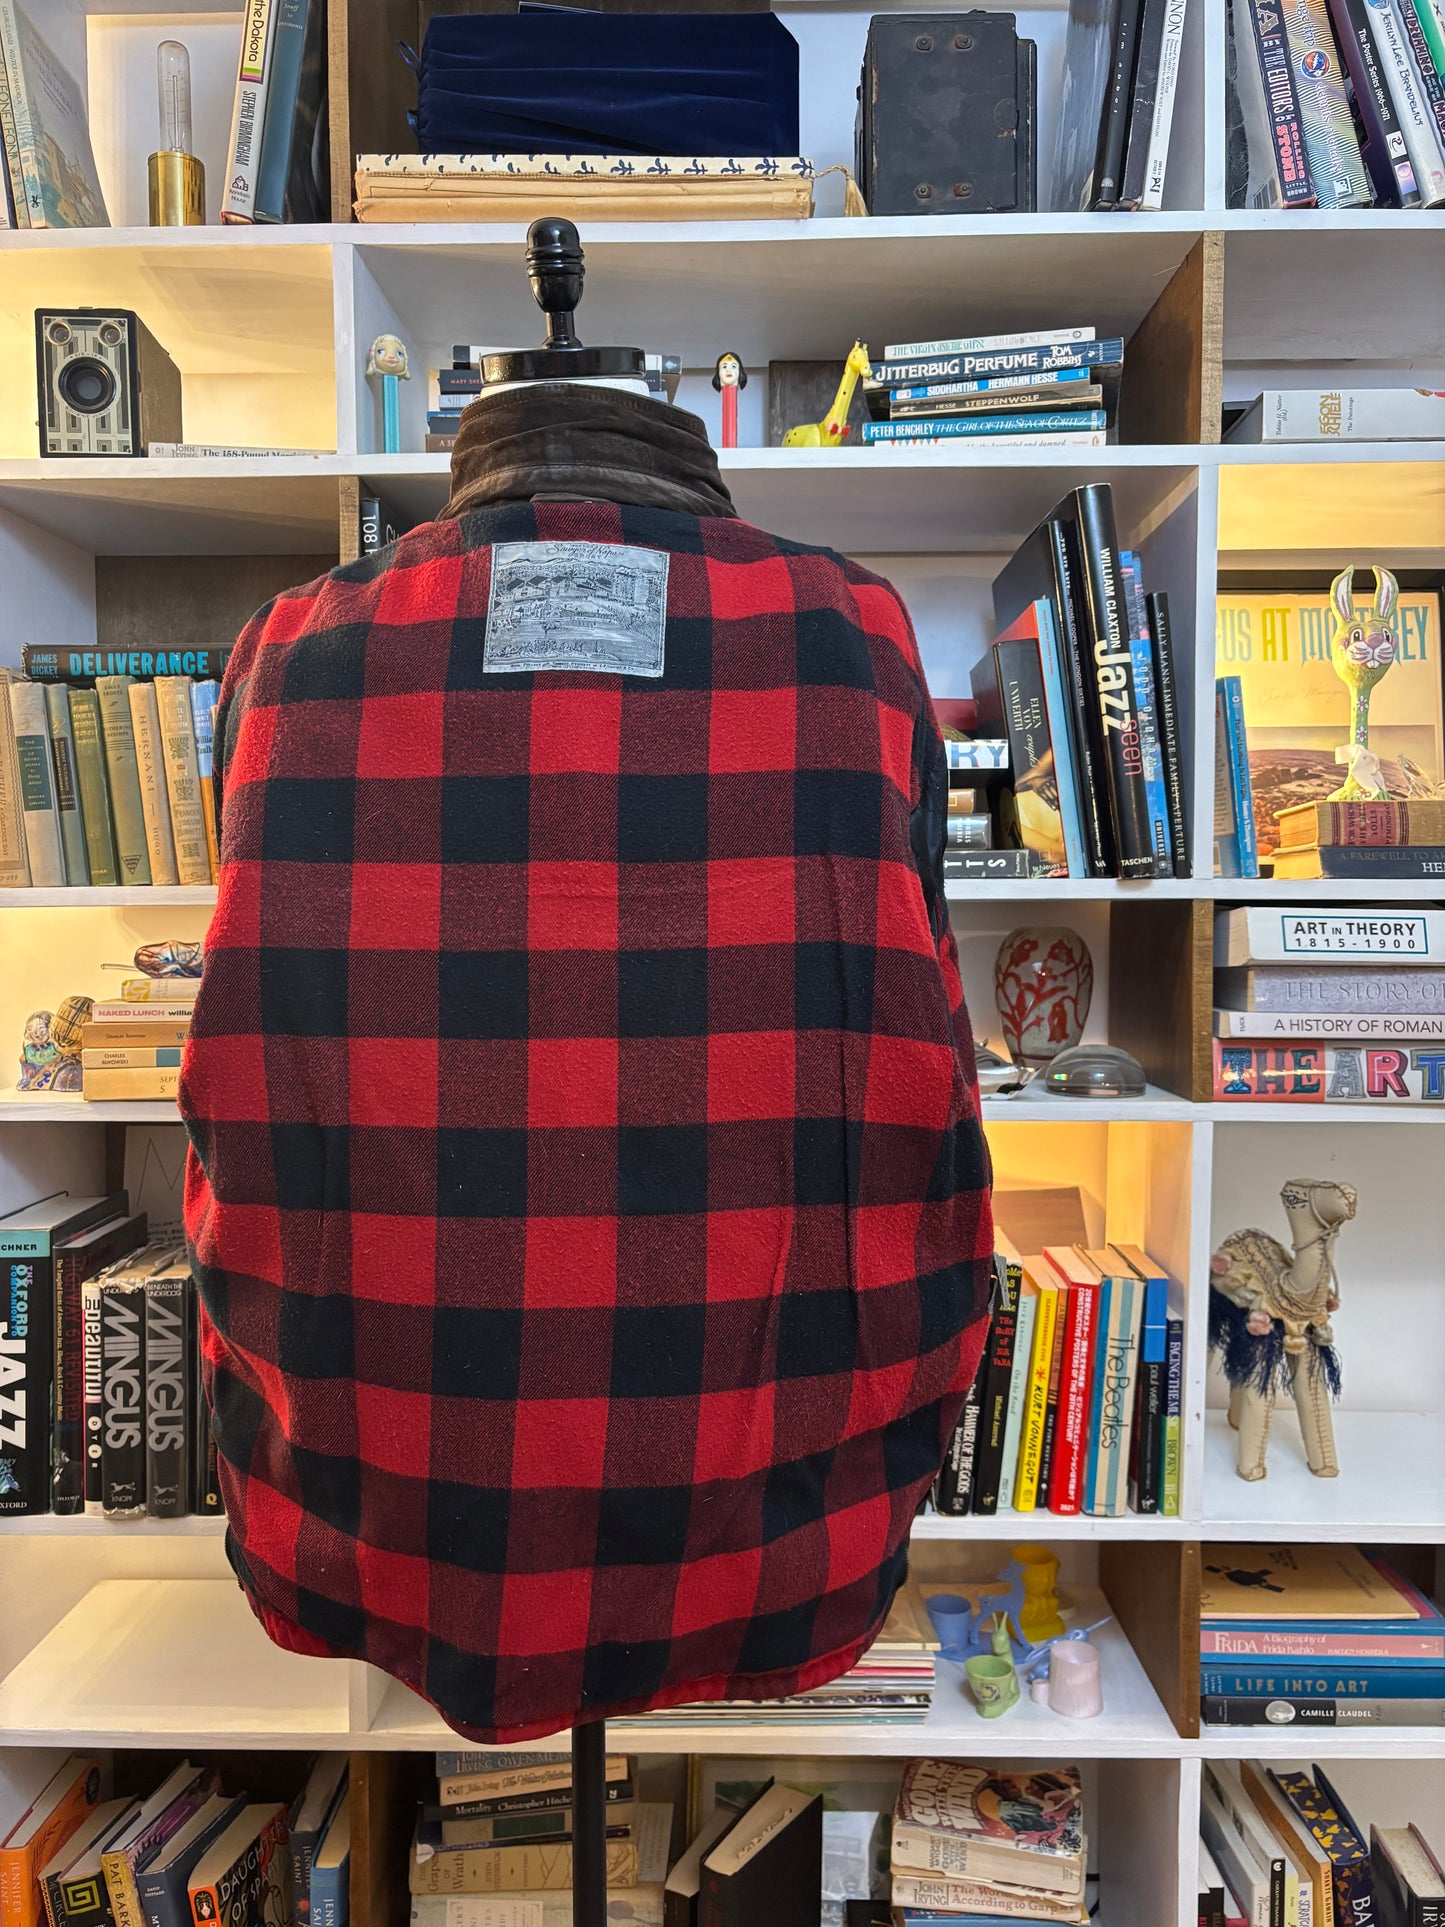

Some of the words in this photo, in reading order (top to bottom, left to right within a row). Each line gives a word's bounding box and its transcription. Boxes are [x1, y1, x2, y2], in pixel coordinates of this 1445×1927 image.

[249, 20, 264, 62] Dakota
[1407, 18, 1435, 76] DRUMMING
[1264, 48, 1286, 68] THE
[1358, 28, 1368, 43] The
[1363, 43, 1375, 66] Poster
[1369, 65, 1380, 85] Series
[240, 91, 256, 120] STEPHEN
[1267, 68, 1294, 114] EDITORS
[235, 120, 254, 166] BIRMINGHAM
[1276, 125, 1297, 182] STONE
[1291, 122, 1306, 179] ROLLING
[893, 346, 908, 356] THE
[910, 344, 936, 354] VIRGIN
[1042, 355, 1082, 369] ROBBINS
[1050, 345, 1072, 358] TOM
[876, 359, 959, 382] JITTERBUG
[964, 352, 1038, 374] PERFUME
[927, 381, 978, 396] SIDDHARTHA
[988, 374, 1030, 390] HERMANN
[1031, 371, 1058, 385] HESSE
[936, 402, 956, 410] HESSE
[965, 394, 1040, 408] STEPPENWOLF
[870, 424, 894, 438] PETER
[896, 422, 934, 437] BENCHLEY
[176, 444, 195, 452] JOHN
[202, 448, 220, 457] The
[1100, 548, 1116, 597] WILLIAM
[1106, 600, 1121, 648] CLAXTON
[1156, 612, 1166, 646] SALLY
[1261, 608, 1290, 662] AT
[32, 654, 58, 664] JAMES
[32, 666, 58, 676] DICKEY
[69, 652, 210, 676] DELIVERANCE
[1160, 651, 1170, 684] MANN
[1094, 640, 1132, 736] Jazz
[1008, 680, 1024, 732] UNWERTH
[1022, 708, 1032, 730] VON
[1030, 696, 1042, 728] ELLEN
[1163, 689, 1176, 754] IMMEDIATE
[1026, 734, 1038, 768] couples
[1120, 720, 1142, 776] seen
[139, 715, 156, 792] HERNANI
[152, 827, 161, 857] HUGO
[1169, 758, 1180, 800] FAMILY
[1173, 804, 1185, 862] APERTURE
[1370, 810, 1378, 836] TOLLS
[1156, 821, 1166, 856] UNIVERSE
[1120, 856, 1153, 866] TASCHEN
[1294, 922, 1328, 935] ART
[1331, 926, 1342, 935] IN
[1346, 922, 1416, 936] THEORY
[1283, 981, 1330, 1000] THE
[1338, 982, 1416, 1000] STORY
[1274, 1018, 1286, 1032] A
[1289, 1018, 1354, 1032] HISTORY
[1357, 1018, 1380, 1032] OF
[1383, 1020, 1444, 1034] ROMAN
[1221, 1047, 1322, 1095] THE
[1325, 1047, 1445, 1100] ART
[26, 1265, 34, 1285] THE
[10, 1264, 18, 1322] COMPANION
[16, 1264, 28, 1337] OXFORD
[1074, 1288, 1084, 1338] CONSTRUCTIVE
[11, 1324, 18, 1337] TO
[1072, 1338, 1080, 1368] POSTERS
[1108, 1333, 1136, 1372] The
[1169, 1342, 1182, 1378] FACING
[0, 1322, 26, 1450] JAZZ
[64, 1352, 82, 1422] REVISITED
[104, 1296, 142, 1449] MINGUS
[147, 1298, 184, 1452] MINGUS
[1071, 1369, 1078, 1378] OF
[1149, 1364, 1160, 1385] paul
[1032, 1384, 1044, 1418] KURT
[1149, 1386, 1160, 1414] weller
[1168, 1379, 1180, 1400] THE
[964, 1405, 980, 1442] HAMMER
[1102, 1375, 1130, 1449] Beatles
[1166, 1401, 1179, 1432] MUSIC
[1066, 1411, 1074, 1444] CENTURY
[960, 1456, 972, 1470] THE
[962, 1442, 973, 1456] OF
[1026, 1420, 1040, 1484] VONNEGUT
[1167, 1440, 1178, 1476] BROWN
[957, 1470, 972, 1494] GODS
[1214, 1632, 1259, 1654] FRIDA
[1263, 1634, 1270, 1642] A
[1271, 1635, 1316, 1646] Biography
[1317, 1634, 1326, 1644] of
[1263, 1645, 1285, 1654] Frida
[1286, 1645, 1314, 1654] Kahlo
[1236, 1678, 1274, 1692] LIFE
[1284, 1679, 1328, 1692] INTO
[1336, 1680, 1369, 1693] ART
[1300, 1709, 1334, 1717] CAMILLE
[456, 1760, 493, 1773] IRVING
[456, 1804, 492, 1816] Mortality
[498, 1798, 545, 1812] Christopher
[909, 1758, 946, 1826] GONE
[947, 1767, 990, 1831] WIND
[110, 1863, 123, 1886] PAT
[453, 1853, 464, 1890] Wrath
[1323, 1870, 1332, 1893] SHAKTI
[10, 1862, 22, 1914] JENNIFER
[912, 1888, 948, 1906] IRVING
[919, 1882, 944, 1894] JOHN
[952, 1884, 975, 1894] The
[952, 1896, 1012, 1912] According
[1014, 1901, 1026, 1910] to
[1028, 1902, 1058, 1915] Garp
[1324, 1894, 1334, 1923] GAWAIN
